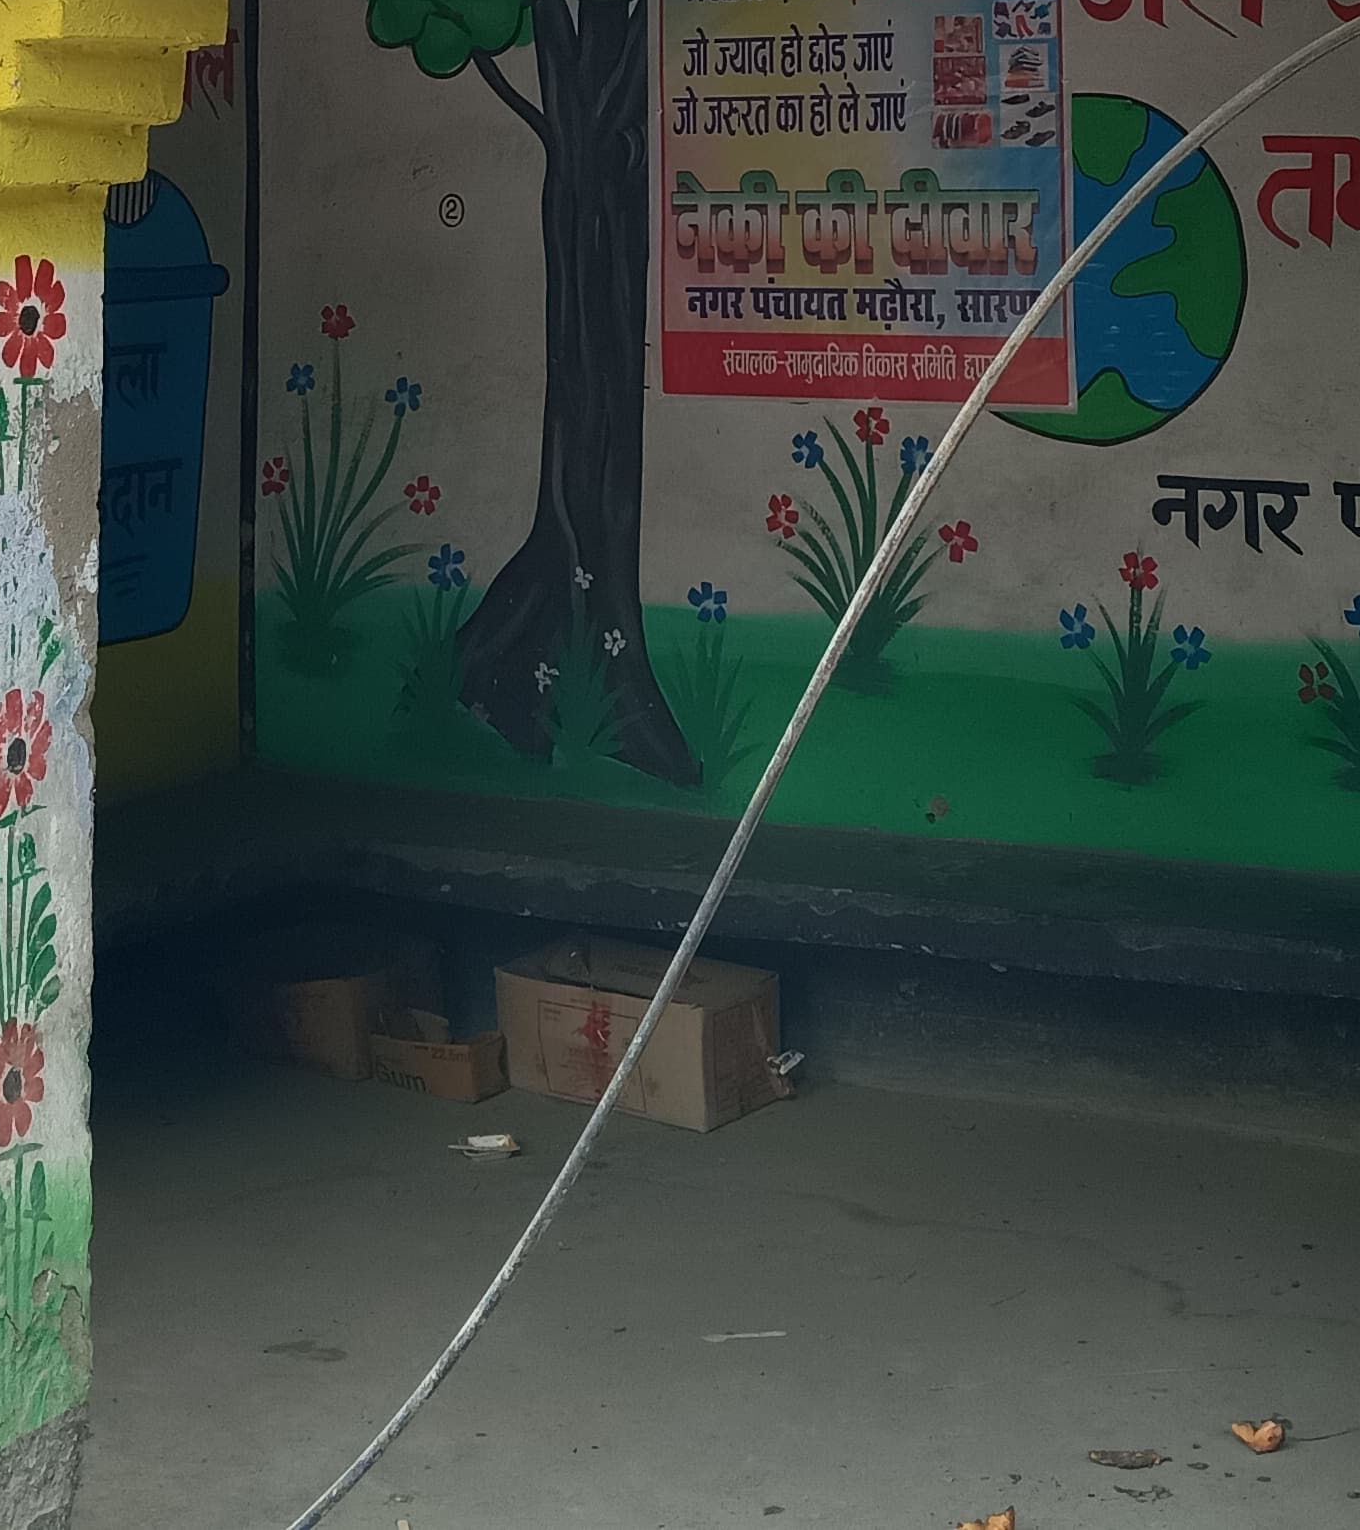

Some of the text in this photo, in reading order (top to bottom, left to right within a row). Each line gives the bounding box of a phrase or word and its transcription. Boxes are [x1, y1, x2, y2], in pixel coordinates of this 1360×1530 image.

[683, 27, 709, 77] जो
[714, 36, 776, 77] ज्यादा
[780, 23, 804, 78] हो
[672, 85, 699, 136] जो
[775, 94, 805, 133] का
[810, 82, 833, 137] हो
[838, 81, 861, 134] ले
[671, 167, 1040, 276] नेकी की दीवार
[685, 286, 746, 319] नगर
[749, 276, 849, 321] पंचायत
[862, 342, 909, 381] विकास
[1152, 474, 1310, 556] नगर
